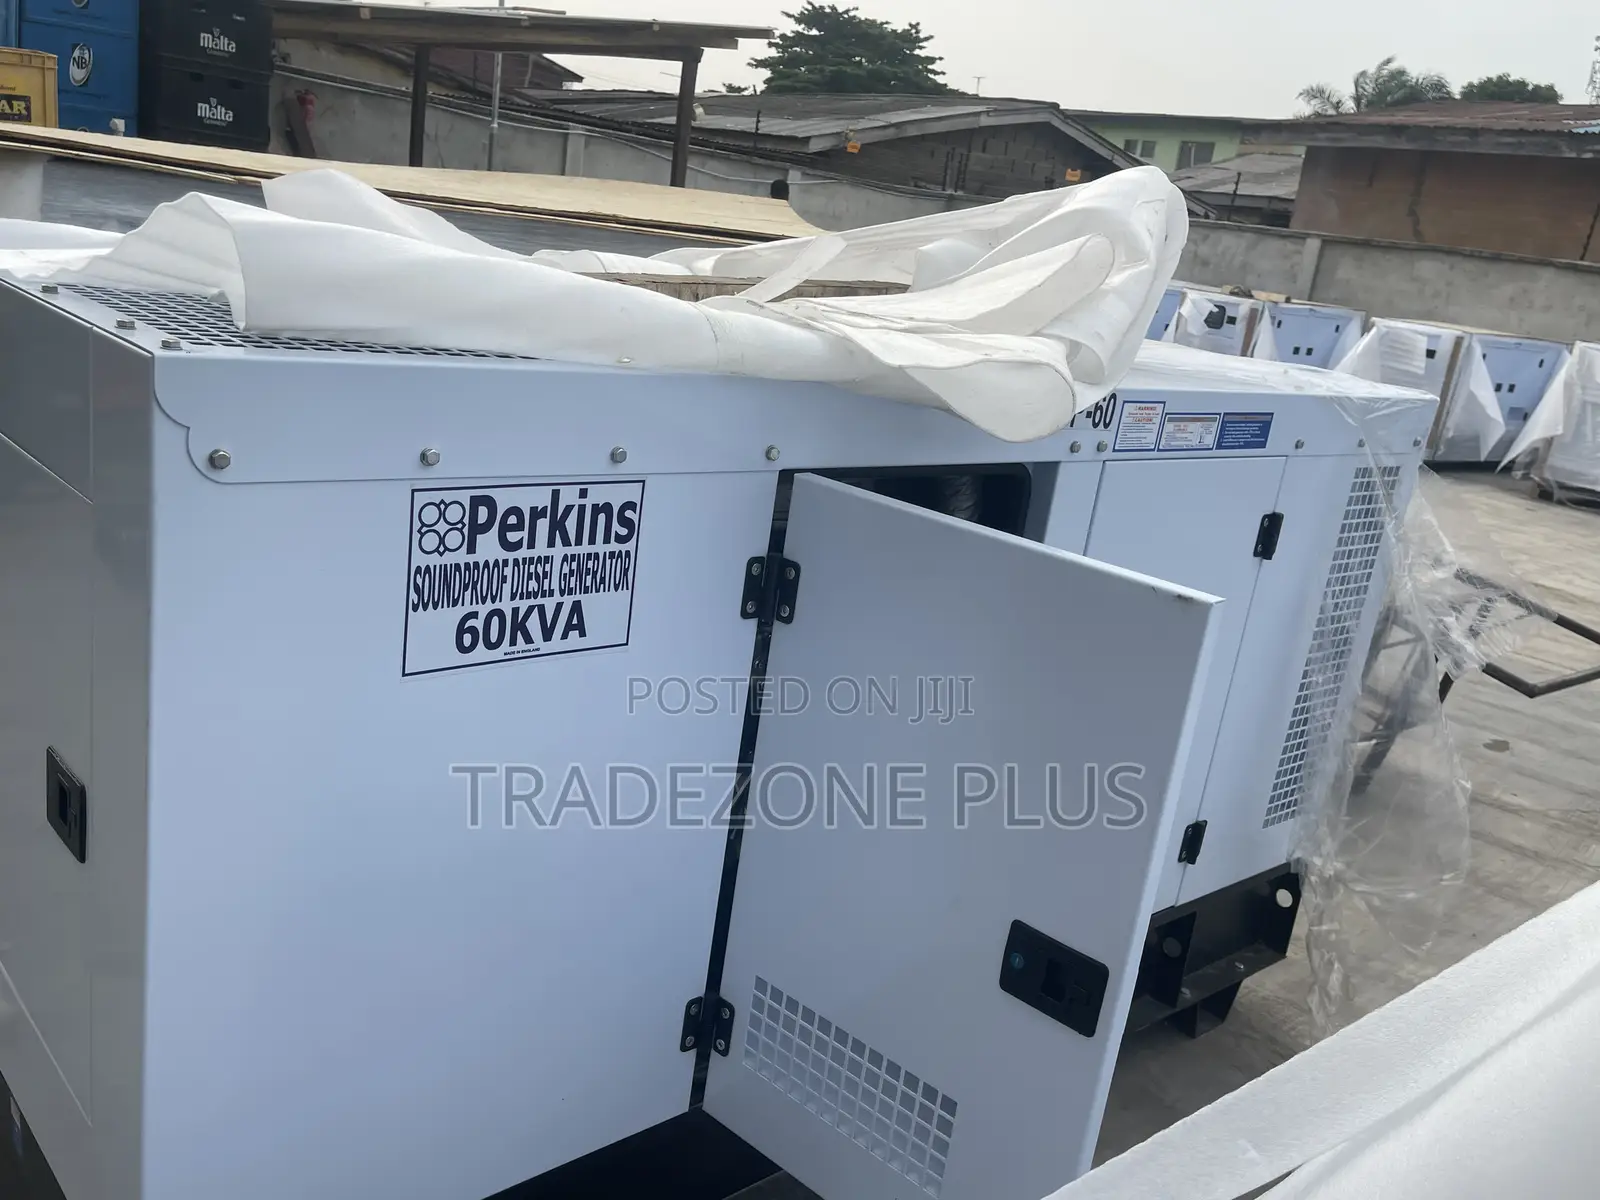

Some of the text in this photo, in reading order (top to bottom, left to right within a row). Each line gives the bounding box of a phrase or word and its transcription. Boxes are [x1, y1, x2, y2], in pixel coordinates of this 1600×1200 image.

[200, 32, 236, 53] malta
[72, 55, 88, 70] NB
[197, 102, 233, 122] malta
[466, 487, 638, 555] Perkins
[411, 549, 632, 613] SOUNDPROOF DIESEL GENERATOR
[455, 600, 587, 655] 60KVA
